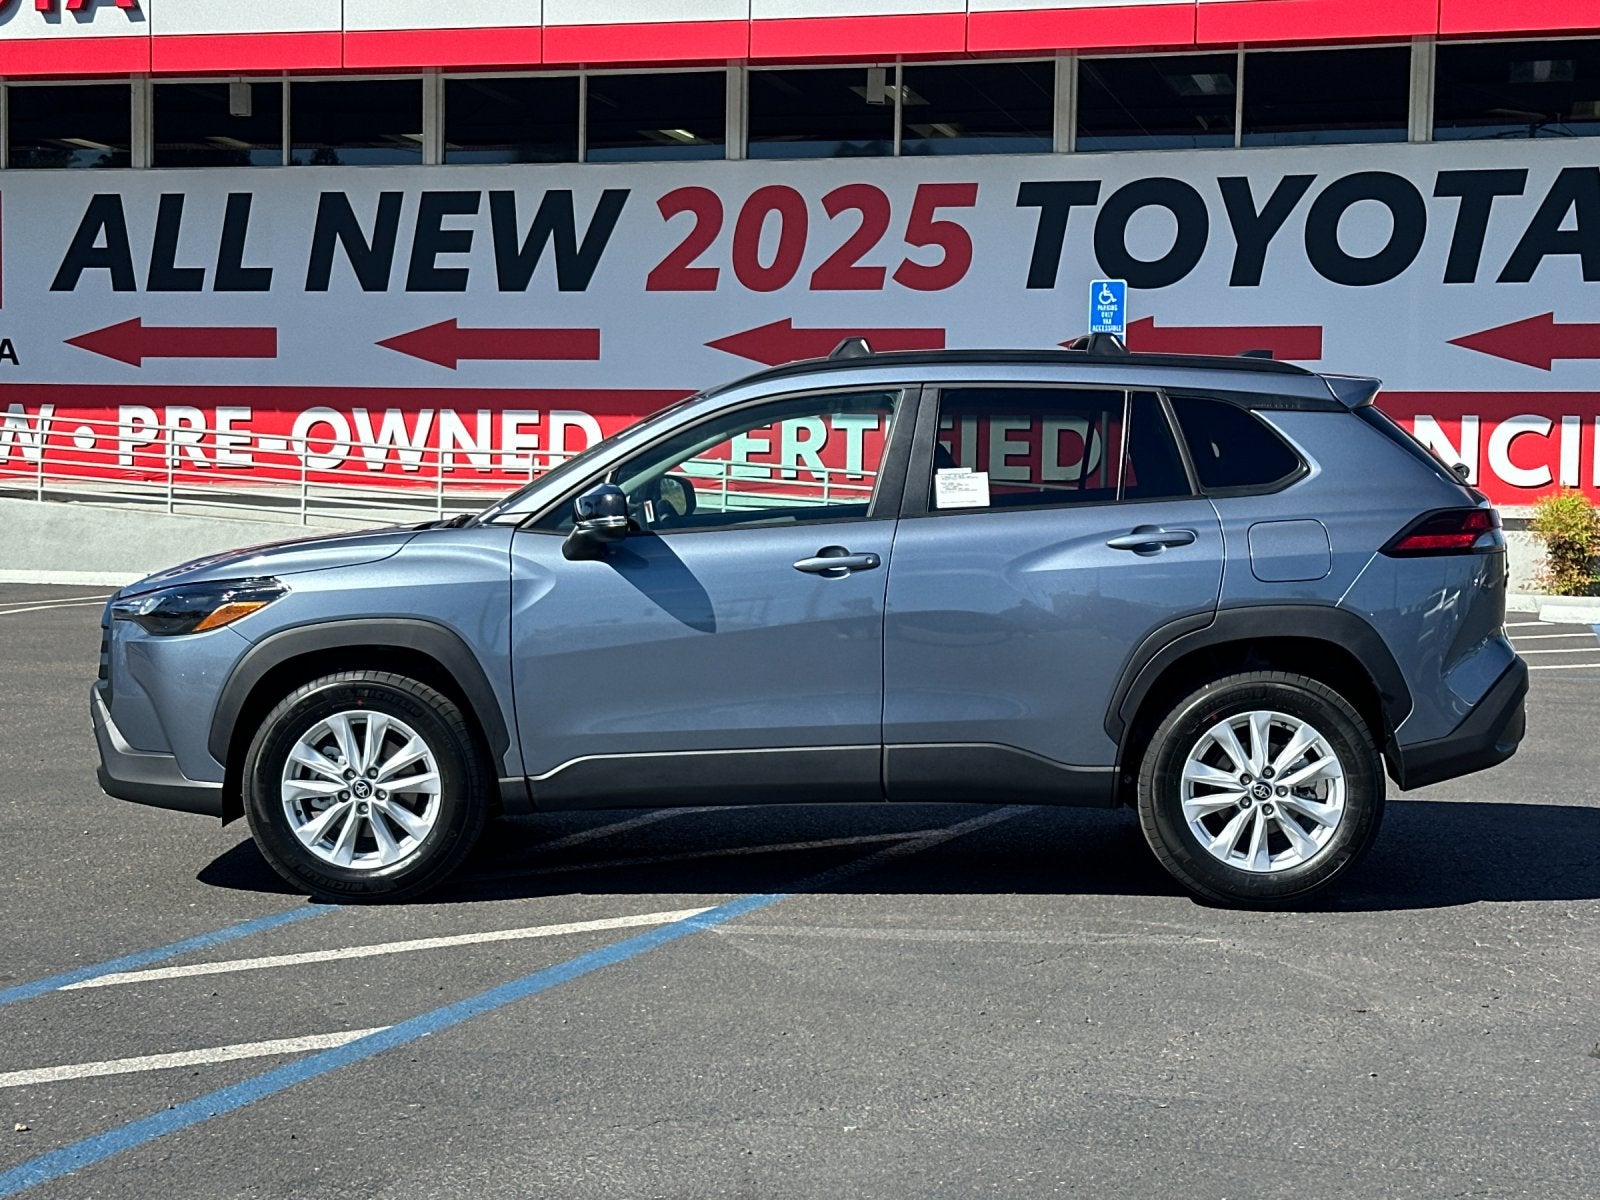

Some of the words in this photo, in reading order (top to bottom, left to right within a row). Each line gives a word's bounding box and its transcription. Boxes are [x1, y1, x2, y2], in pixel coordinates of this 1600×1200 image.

[50, 193, 274, 292] ALL
[304, 189, 631, 292] NEW
[645, 182, 979, 292] 2025
[1016, 167, 1600, 289] TOYOTA
[1092, 324, 1122, 332] ACCESSIBLE
